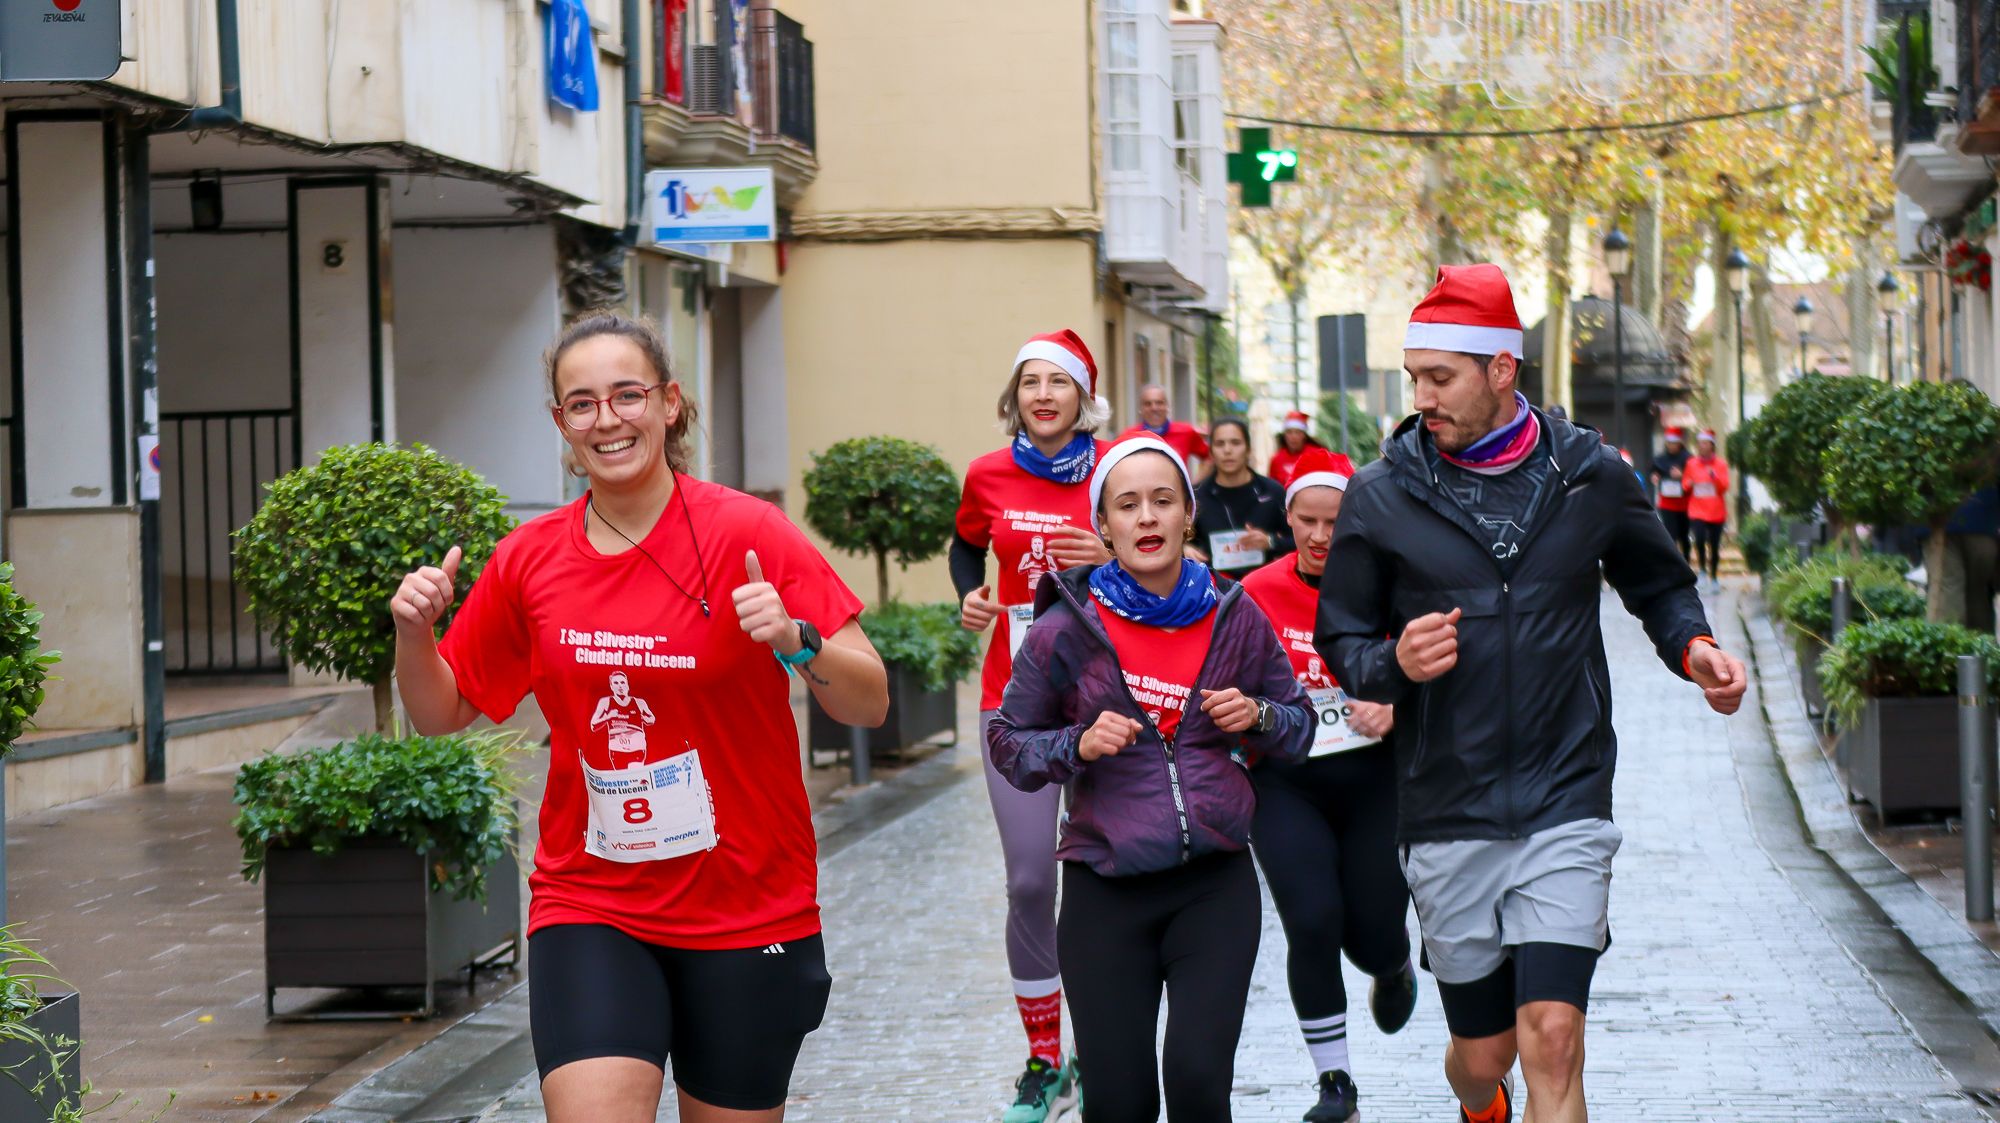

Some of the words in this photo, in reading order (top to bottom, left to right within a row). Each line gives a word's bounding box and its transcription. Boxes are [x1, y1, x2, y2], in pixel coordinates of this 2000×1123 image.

[323, 244, 344, 268] 8
[1008, 510, 1024, 520] San
[1024, 511, 1063, 524] Silvestre
[1012, 520, 1042, 534] Ciudad
[560, 628, 567, 644] I
[568, 629, 592, 646] San
[594, 630, 654, 650] Silvestre
[576, 648, 622, 666] Ciudad
[625, 650, 642, 667] de
[644, 652, 696, 669] Lucena
[1142, 675, 1191, 699] Silvestre
[1164, 696, 1180, 710] de
[618, 785, 648, 794] Lucena
[623, 798, 652, 824] 8
[663, 829, 700, 843] enerplus
[611, 842, 631, 850] vtv
